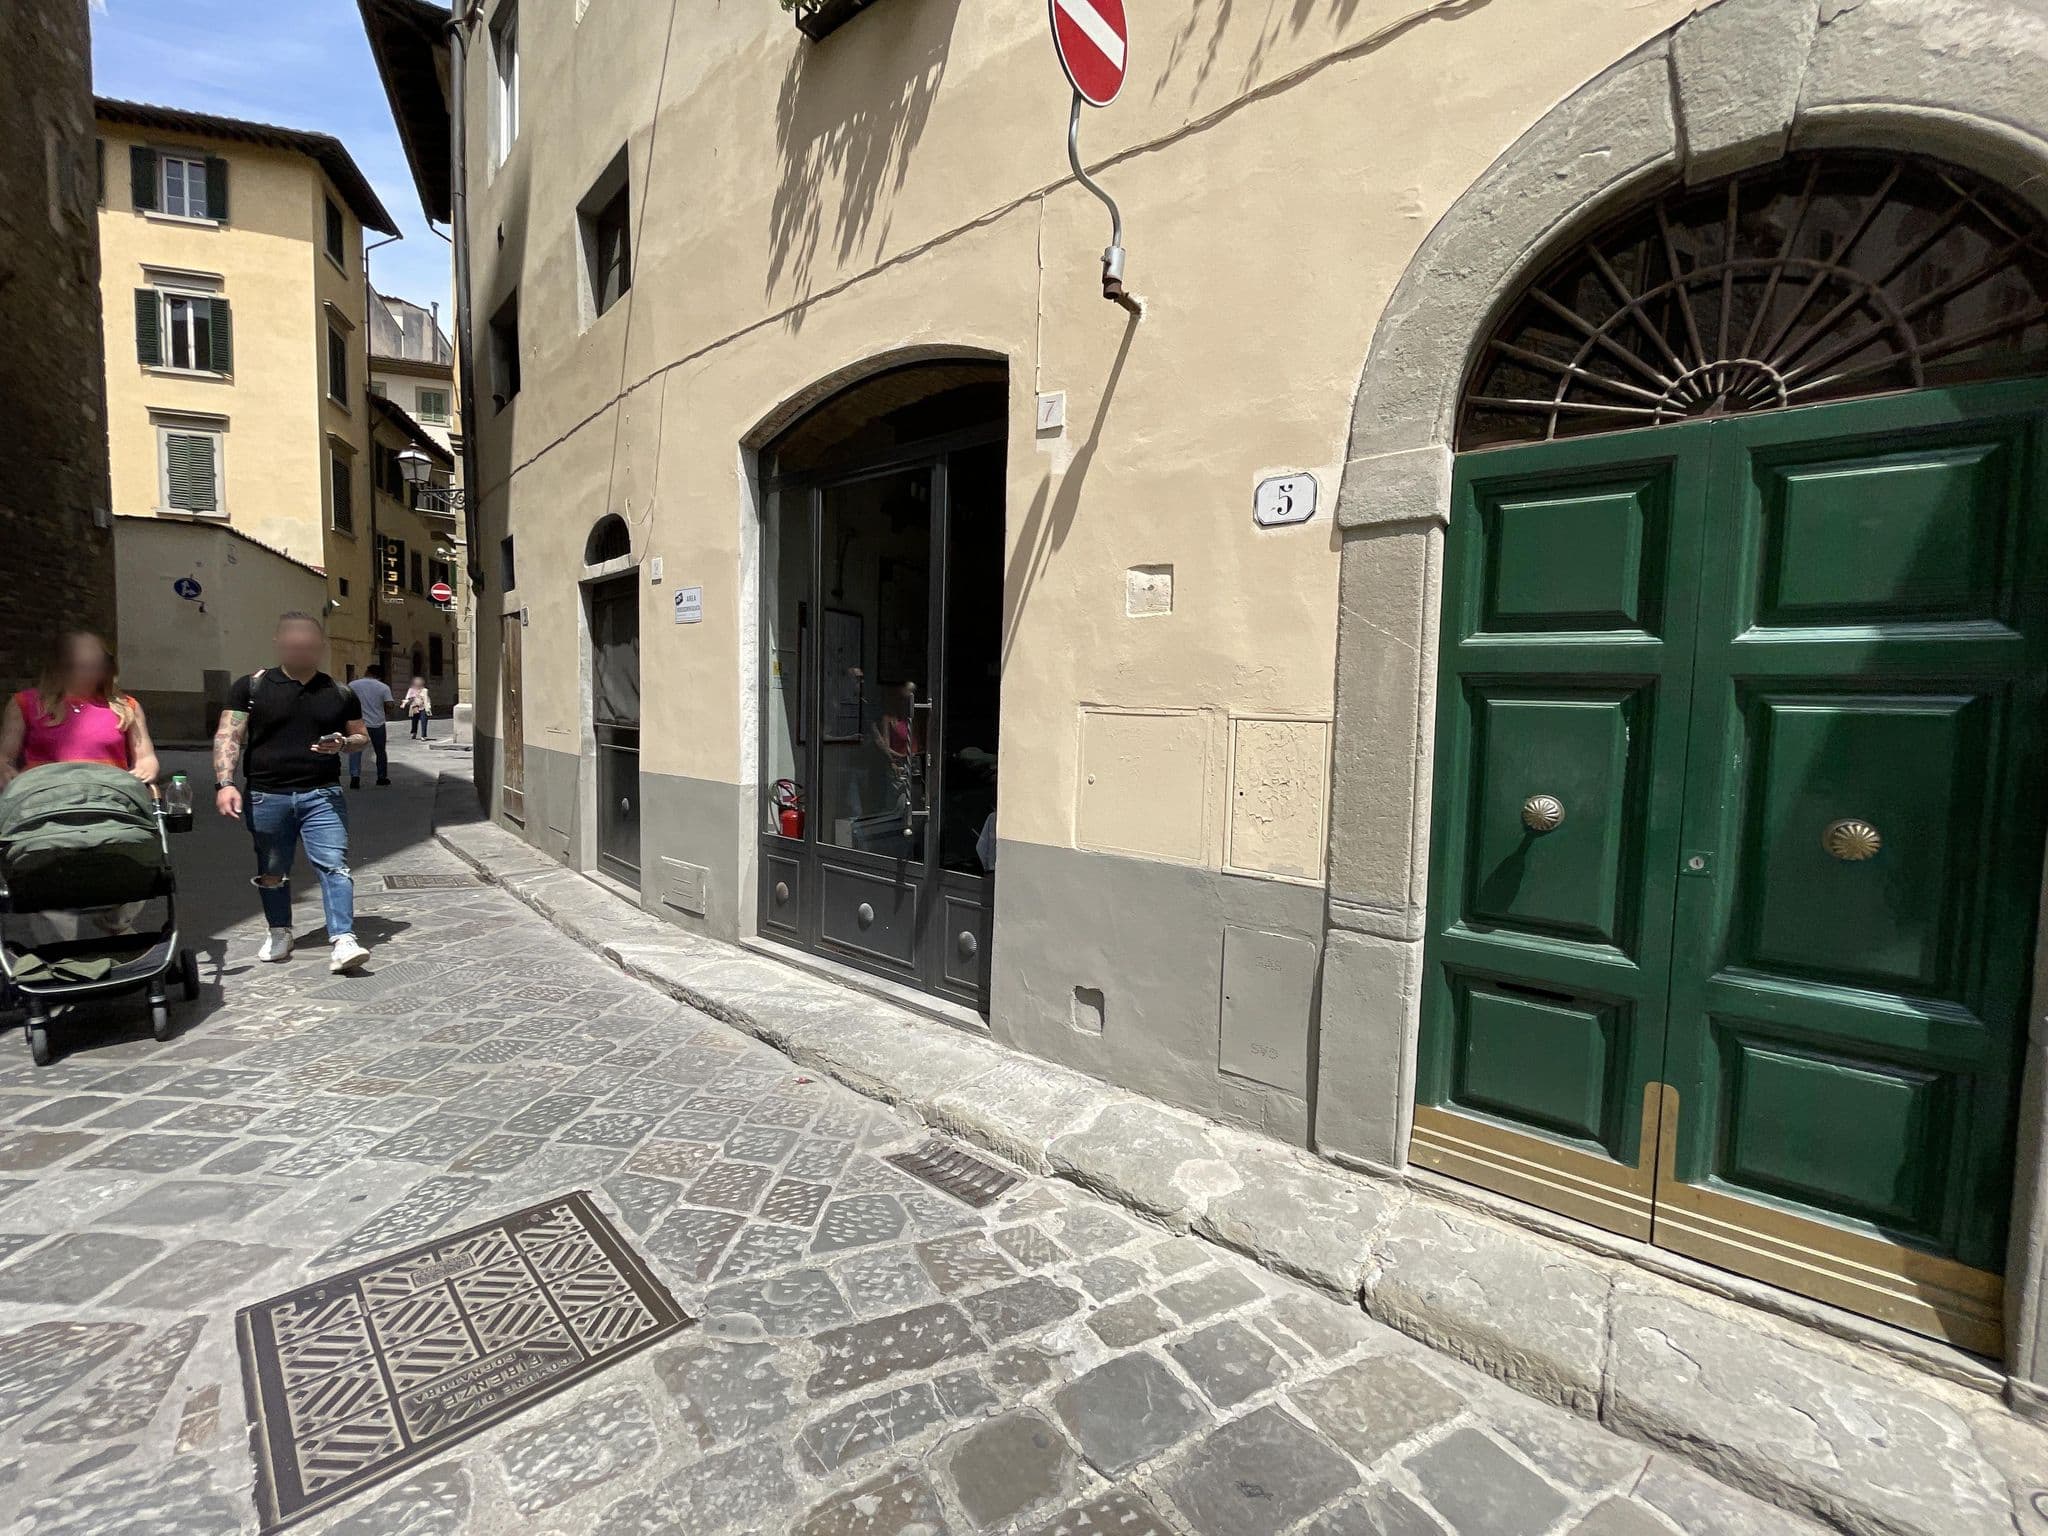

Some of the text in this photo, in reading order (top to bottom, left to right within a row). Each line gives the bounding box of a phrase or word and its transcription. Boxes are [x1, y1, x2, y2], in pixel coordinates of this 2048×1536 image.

[1042, 400, 1057, 423] 7
[1276, 483, 1293, 516] 5
[412, 1351, 517, 1404] FOGNATURA
[440, 1353, 543, 1411] FIRENZE
[476, 1356, 571, 1408] COMUNE DI
